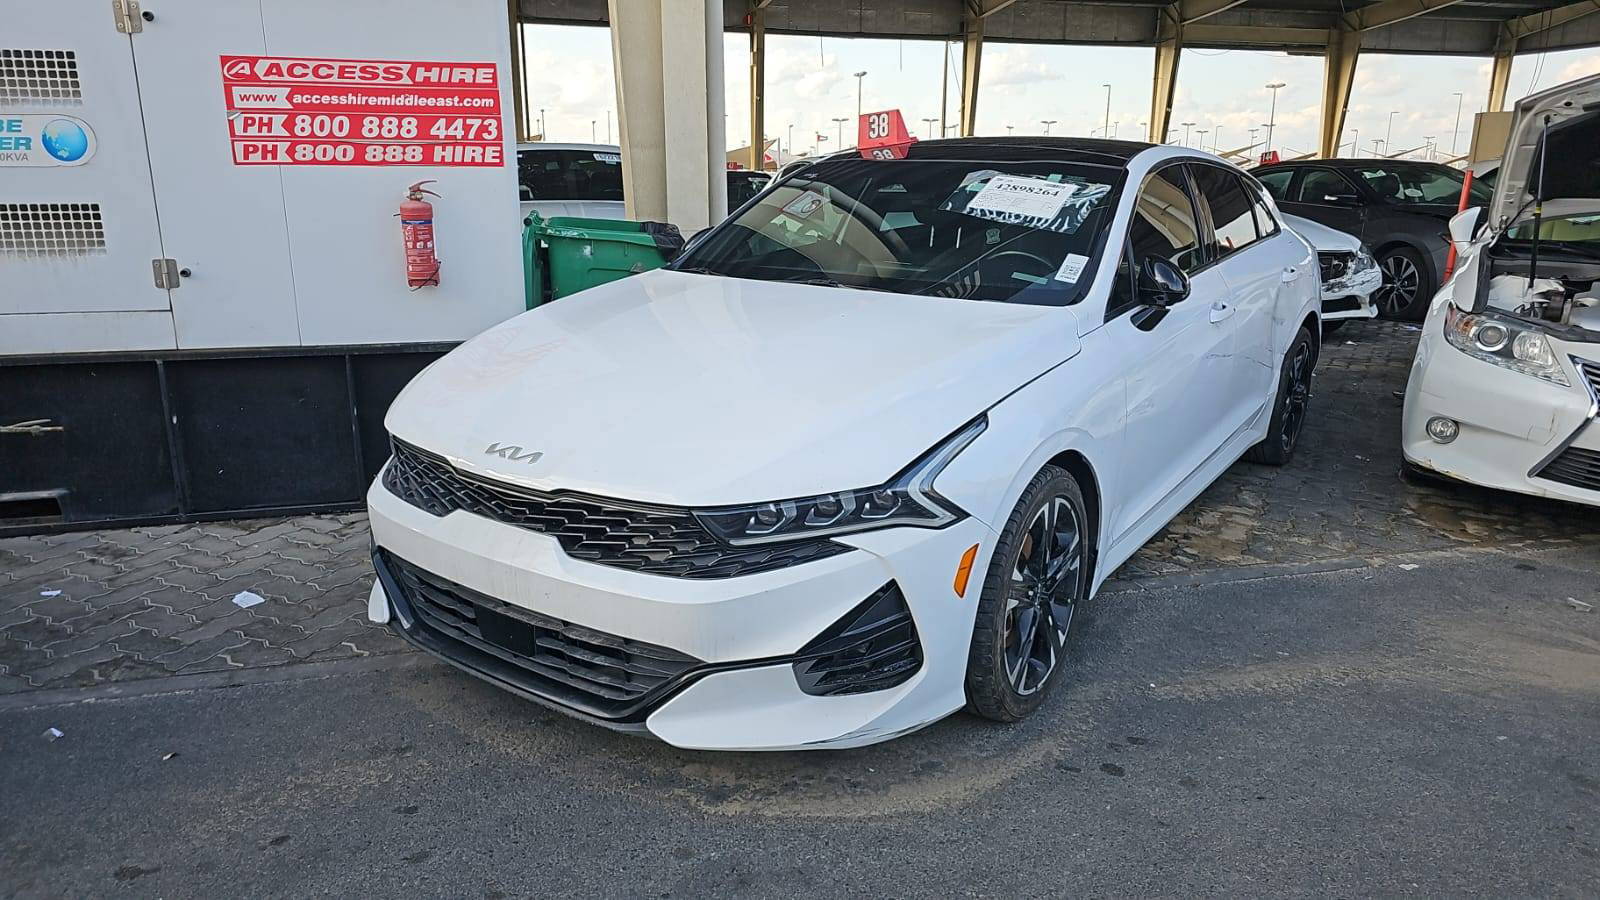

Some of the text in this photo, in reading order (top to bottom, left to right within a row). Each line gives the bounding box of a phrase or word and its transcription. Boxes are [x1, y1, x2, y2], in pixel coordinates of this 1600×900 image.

[263, 62, 404, 81] ACCESS
[415, 66, 495, 84] HIRE
[239, 93, 494, 107] www accesshiremiddleeast.com
[0, 119, 23, 133] E
[242, 114, 498, 140] PH 800 888 4473
[869, 113, 889, 138] 38
[243, 143, 501, 163] PH 800 888 HIRE
[994, 183, 1060, 197] 42898264
[484, 441, 545, 465] KIA
